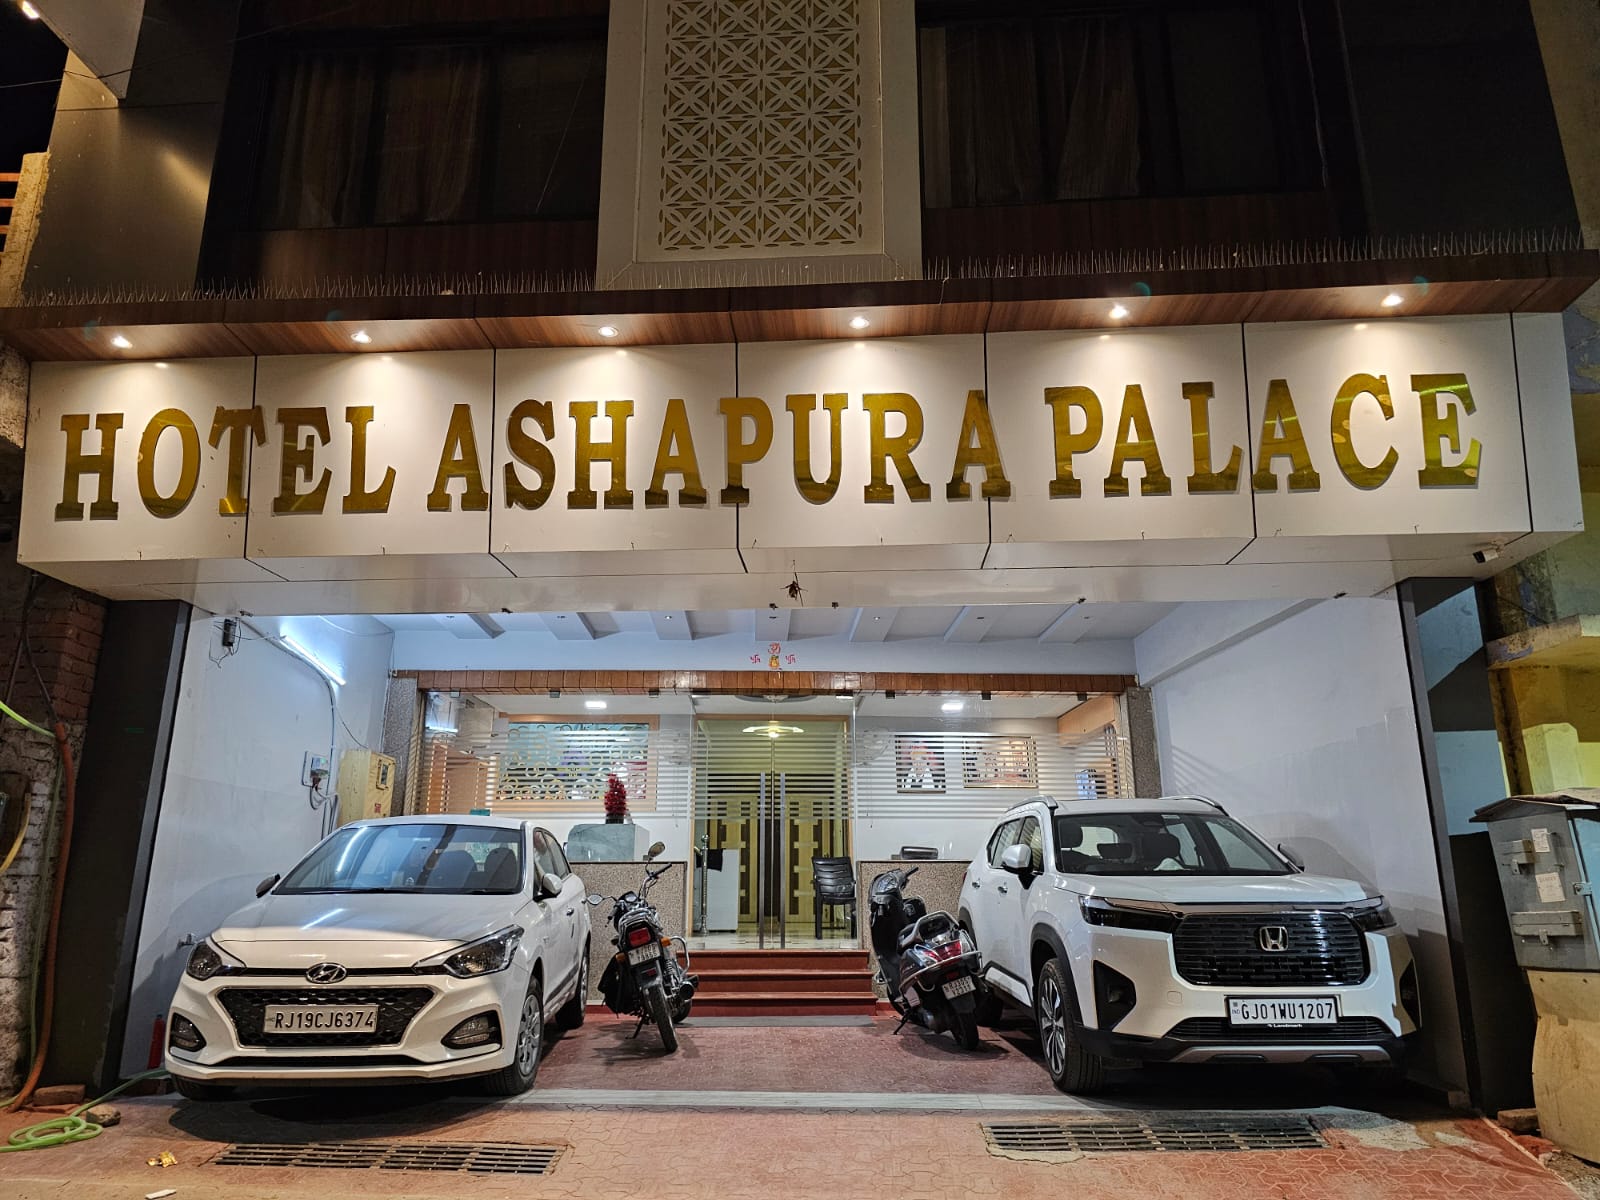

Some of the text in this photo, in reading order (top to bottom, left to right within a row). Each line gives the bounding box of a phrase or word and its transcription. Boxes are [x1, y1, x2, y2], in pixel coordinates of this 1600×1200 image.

[55, 372, 1481, 521] HOTEL ASHAPURA PALACE
[1241, 1003, 1333, 1020] GJ01WU1207
[274, 1012, 375, 1029] RJ19CJ6374
